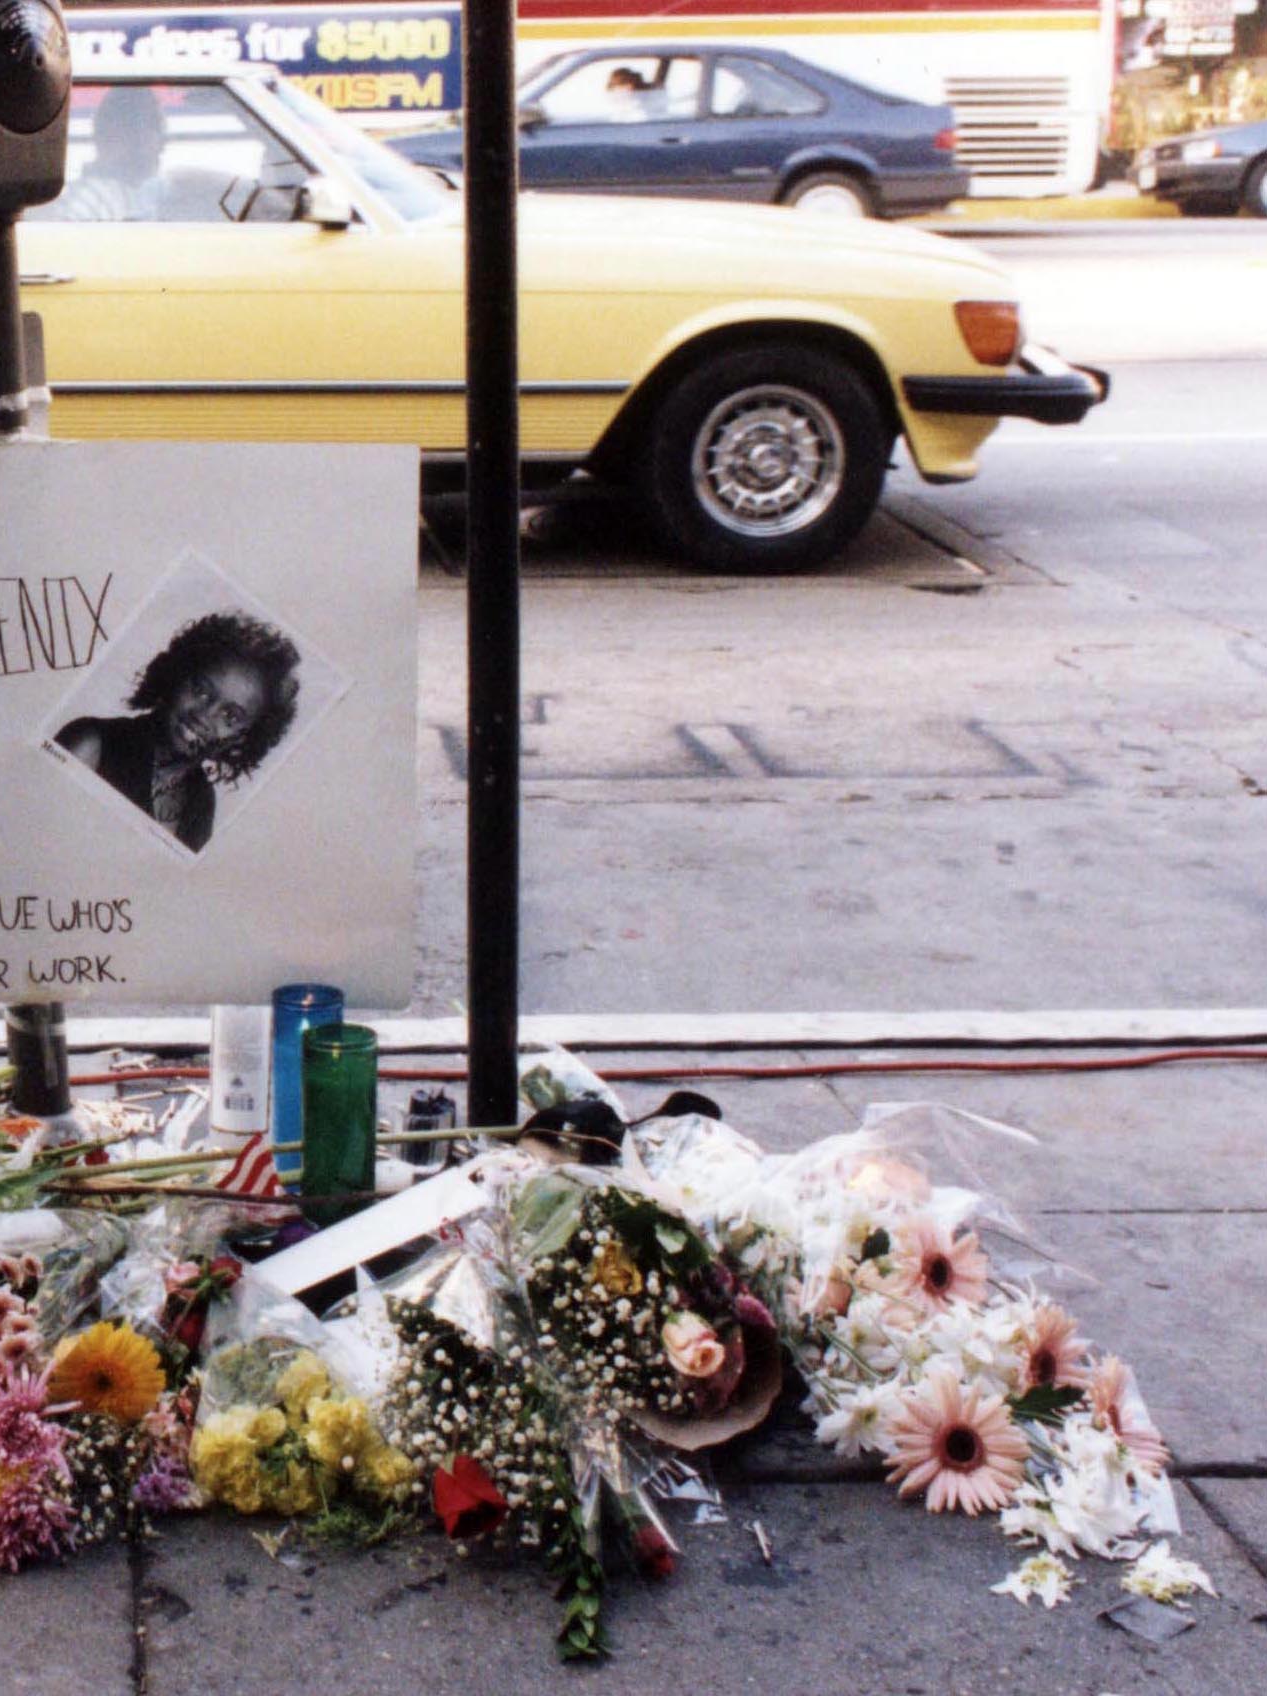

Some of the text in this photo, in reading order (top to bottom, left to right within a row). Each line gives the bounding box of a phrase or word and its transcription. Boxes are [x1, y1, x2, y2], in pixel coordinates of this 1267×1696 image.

[246, 22, 311, 61] for
[316, 19, 450, 62] $5000
[29, 955, 128, 984] WORK.
